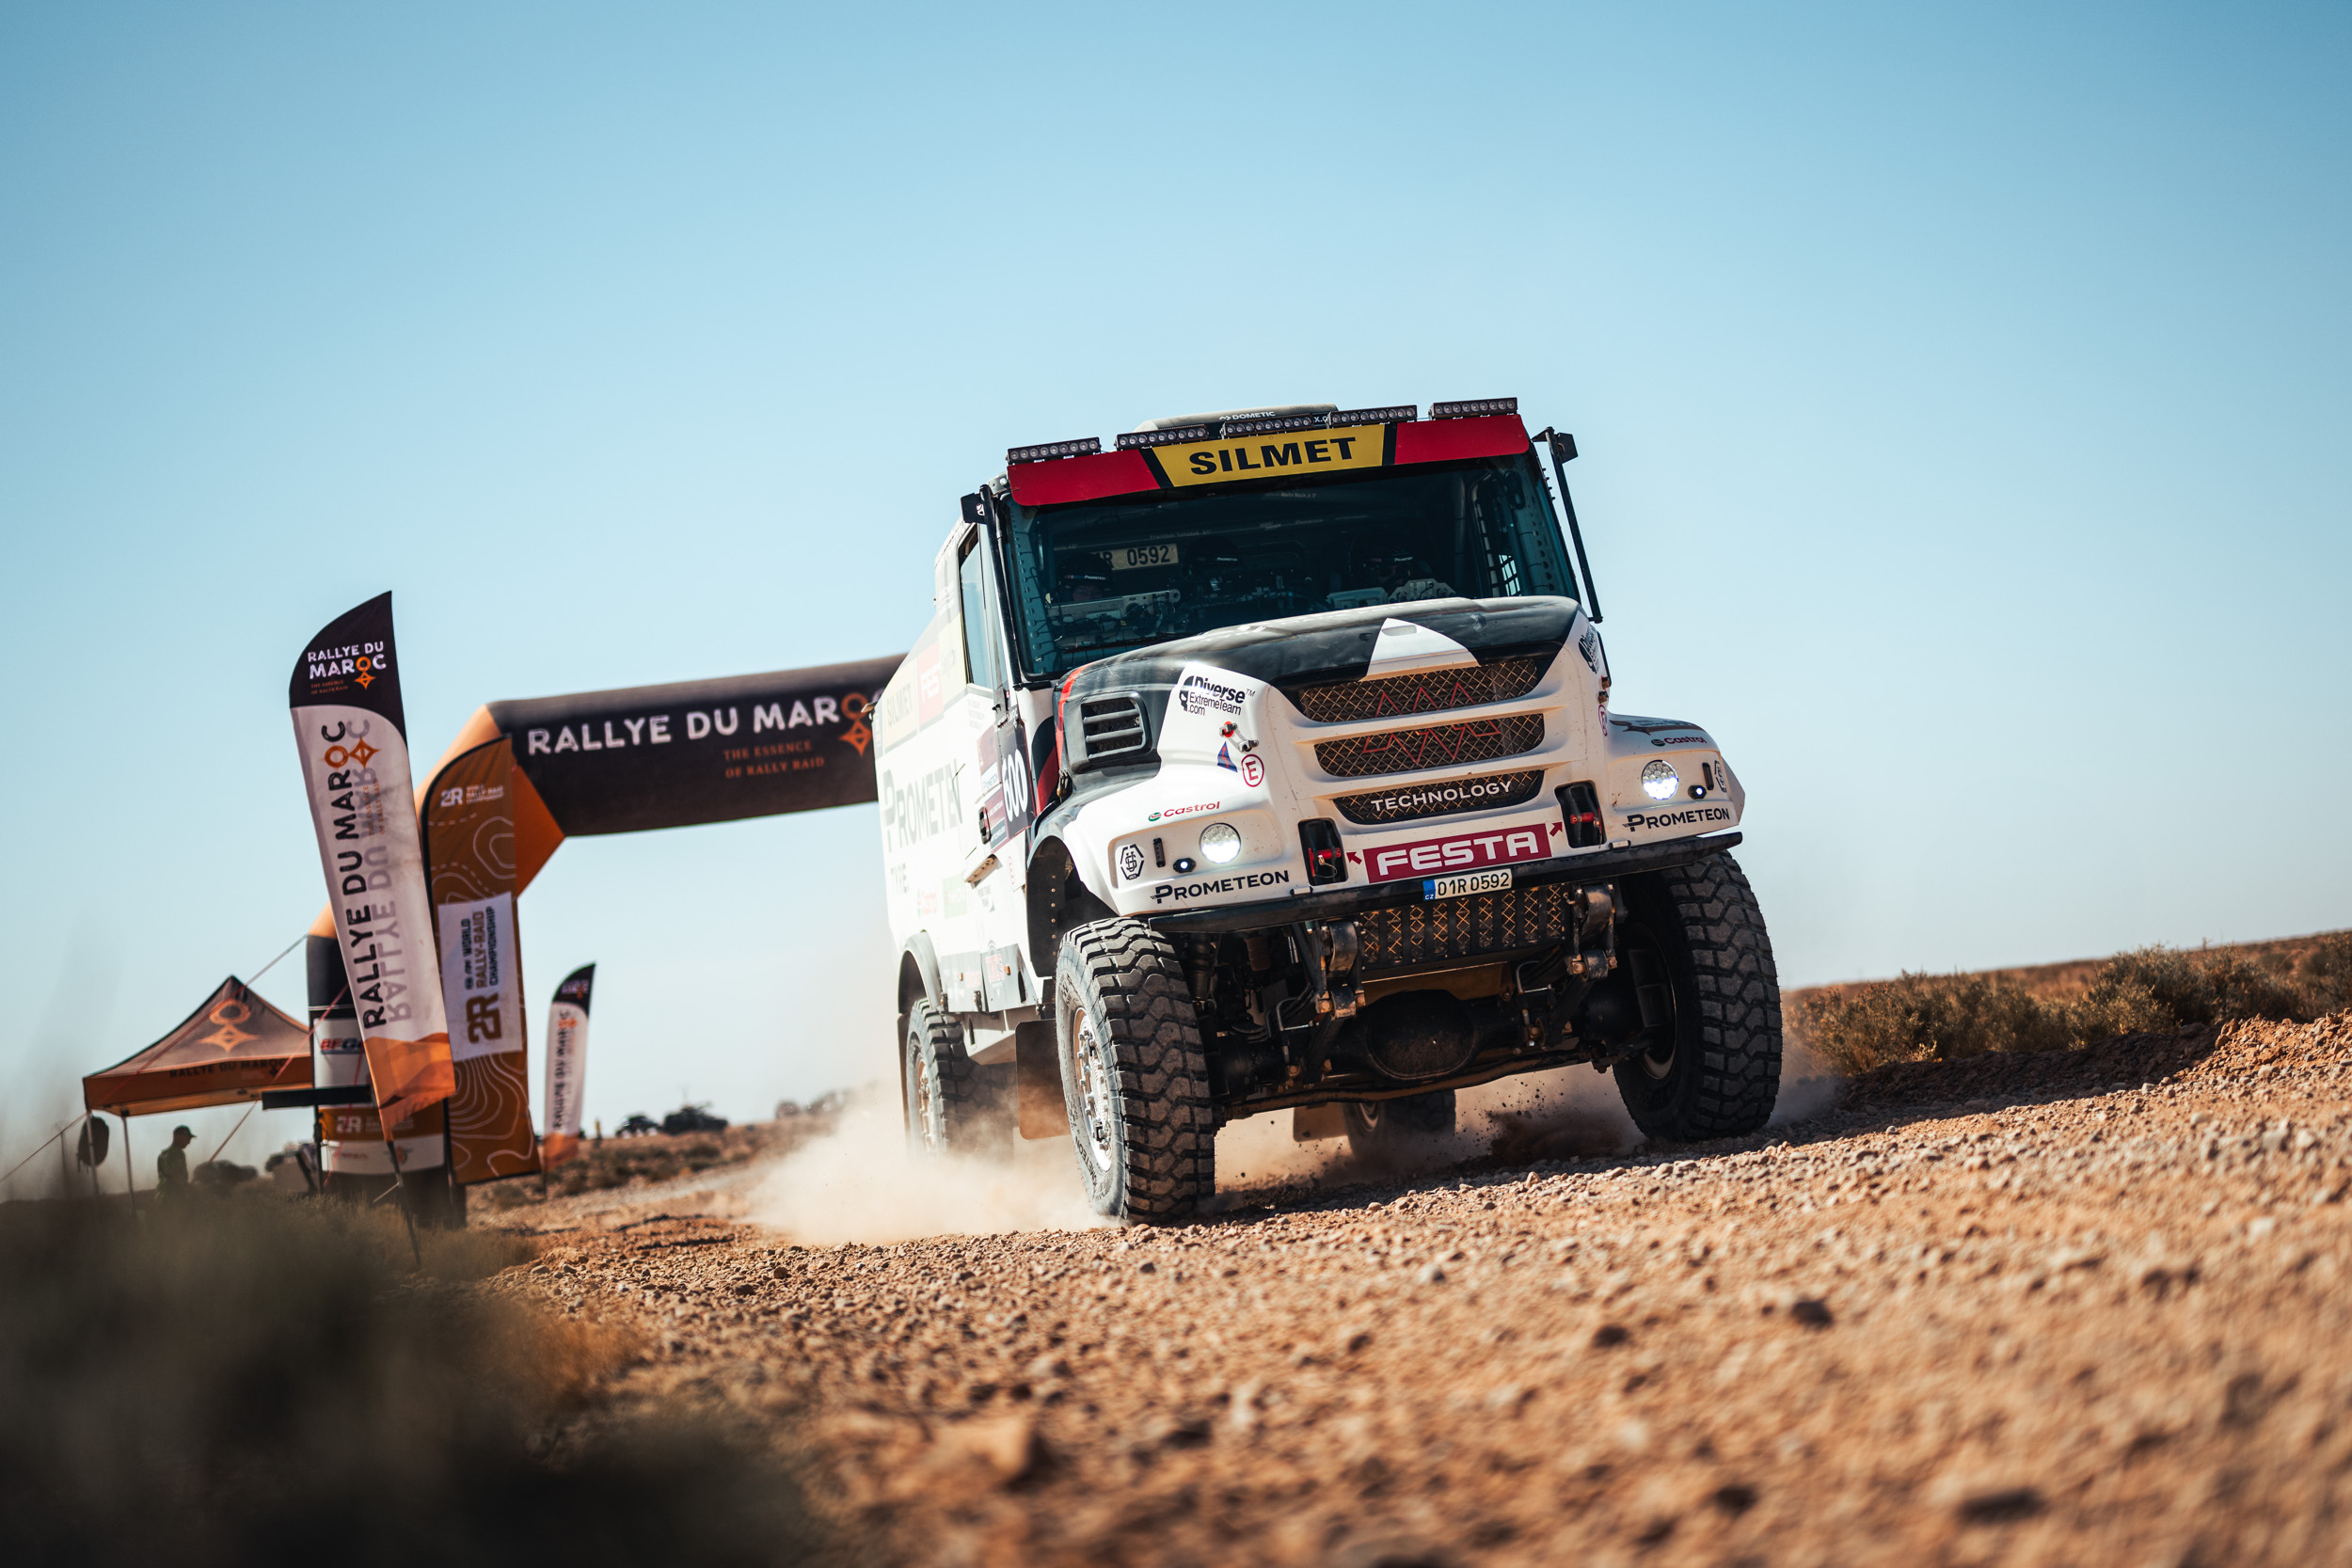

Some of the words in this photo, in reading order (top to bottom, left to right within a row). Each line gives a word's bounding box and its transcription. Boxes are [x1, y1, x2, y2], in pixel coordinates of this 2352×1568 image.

[1232, 411, 1276, 420] DOMETIC
[1189, 436, 1356, 476] SILMET
[1127, 545, 1171, 566] 0592
[307, 644, 360, 662] RALLYE
[364, 641, 384, 655] DU
[309, 654, 387, 680] MAROC
[1194, 675, 1246, 704] Diverse
[886, 682, 914, 728] SILMET
[1187, 704, 1206, 716] .com
[1189, 691, 1242, 716] ExtremeTeam
[527, 715, 672, 755] RALLYE
[686, 706, 739, 741] DU
[1663, 736, 1708, 744] Castrol
[723, 749, 749, 761] THE
[754, 739, 812, 758] ESSENCE
[724, 767, 741, 778] OF
[746, 761, 787, 776] RALLY
[792, 756, 825, 769] RAID
[1245, 760, 1259, 781] E
[321, 721, 359, 840] MAROC
[1002, 749, 1028, 822] 600
[440, 786, 463, 807] 2R
[1163, 800, 1220, 817] Castrol
[1370, 780, 1512, 812] TECHNOLOGY
[1623, 807, 1730, 832] PROMETEON
[1376, 831, 1539, 876] FESTA
[337, 850, 368, 895] DU
[1437, 877, 1468, 896] 01R
[1470, 872, 1510, 892] 0592
[1152, 870, 1290, 904] PROMETEON
[471, 910, 488, 990] RALLY-RAID
[345, 904, 387, 1029] RALLYE
[465, 991, 502, 1044] 2R
